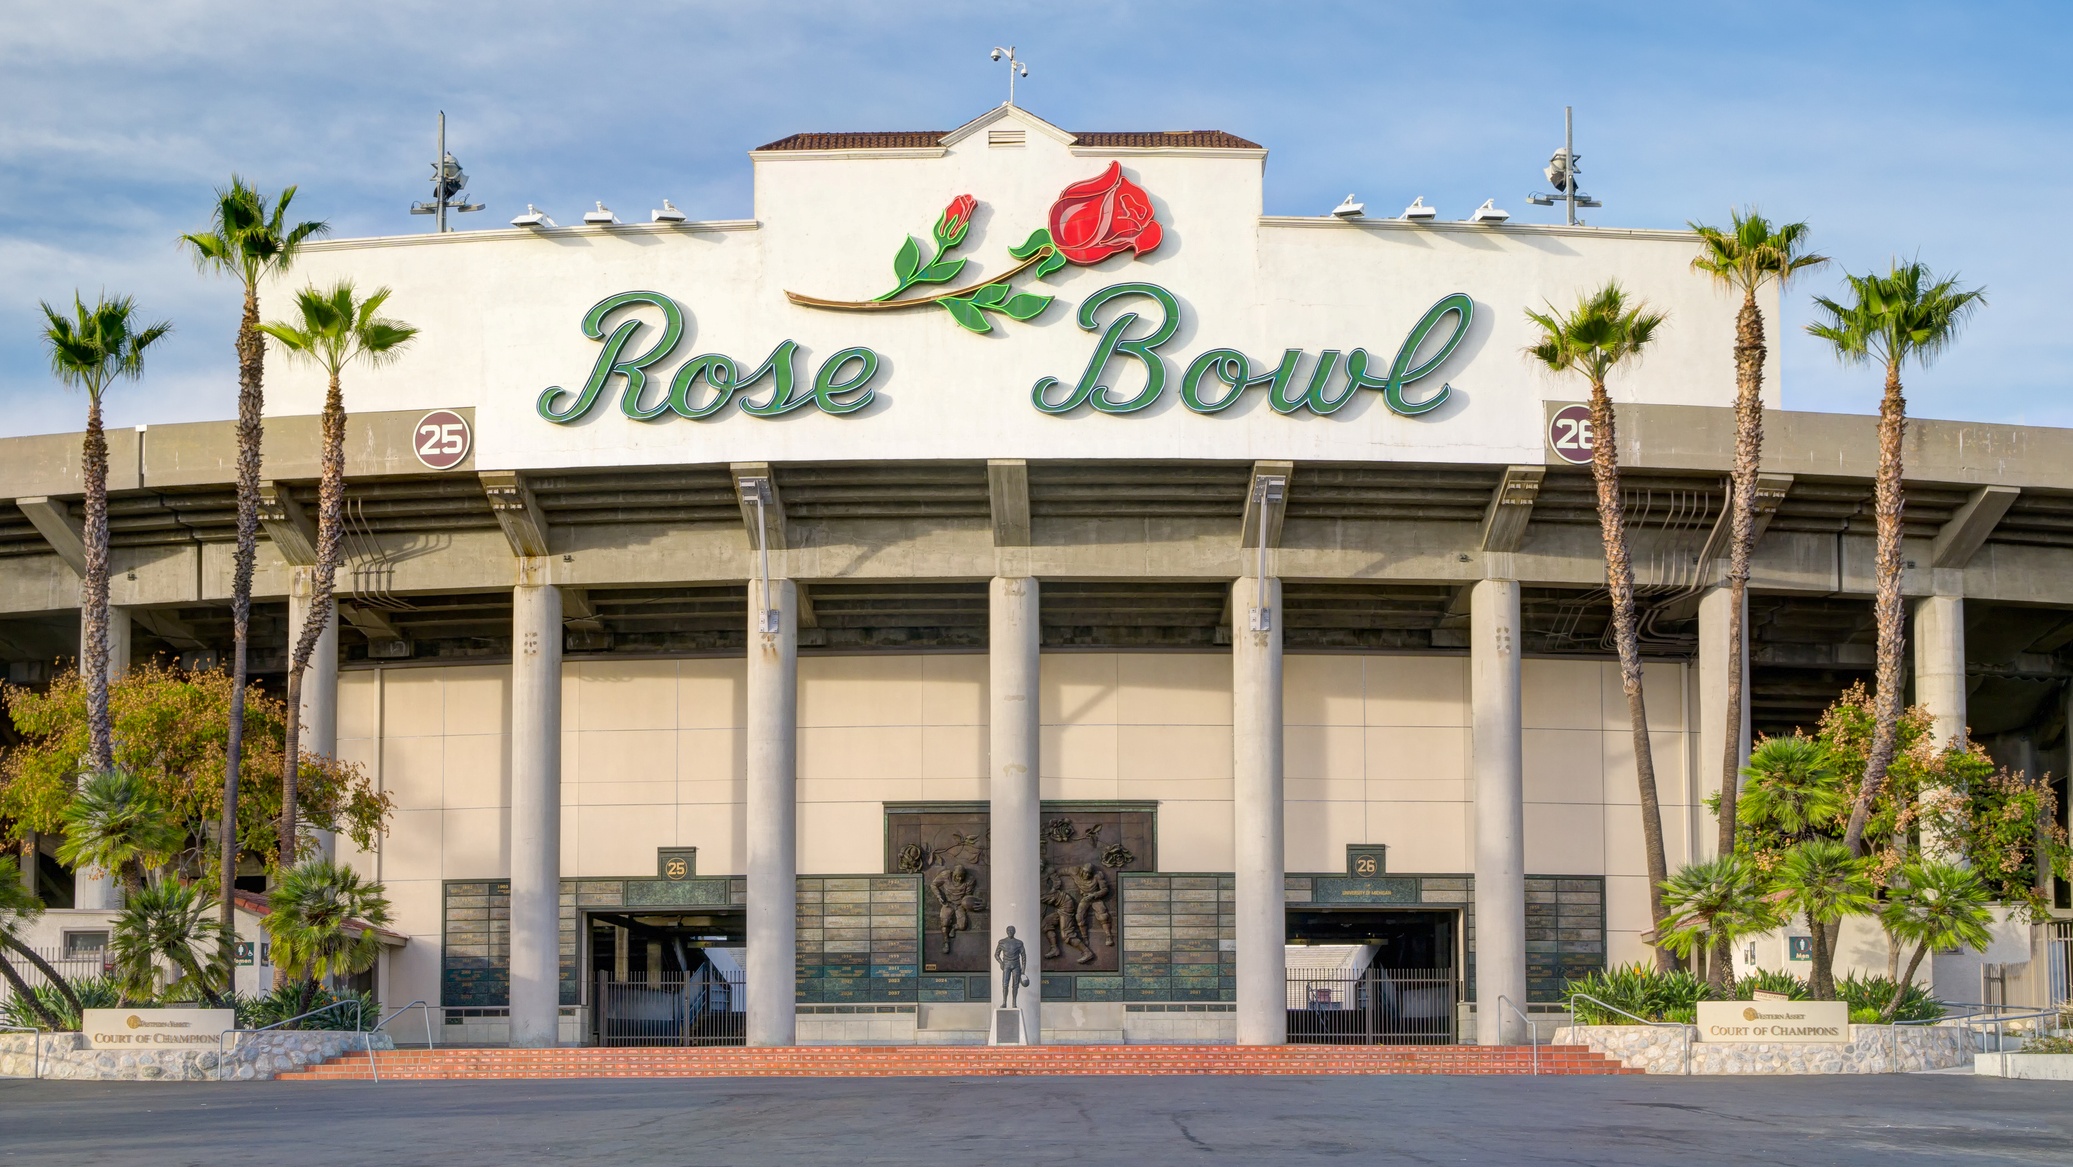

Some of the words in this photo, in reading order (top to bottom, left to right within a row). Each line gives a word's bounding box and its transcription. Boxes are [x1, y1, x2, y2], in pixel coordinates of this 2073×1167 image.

[536, 290, 880, 424] Rose
[1030, 281, 1475, 416] Bowl
[419, 423, 463, 455] 25
[667, 862, 685, 875] 25
[1357, 859, 1375, 873] 26
[1755, 1012, 1785, 1020] WESTERN
[1785, 1012, 1806, 1020] ASSET
[1710, 1025, 1750, 1036] COURT
[1753, 1026, 1769, 1036] OF
[1770, 1025, 1840, 1036] CHAMPIONS
[94, 1033, 133, 1044] COURT
[135, 1034, 152, 1044] OF
[153, 1033, 220, 1044] CHAMPIONS
